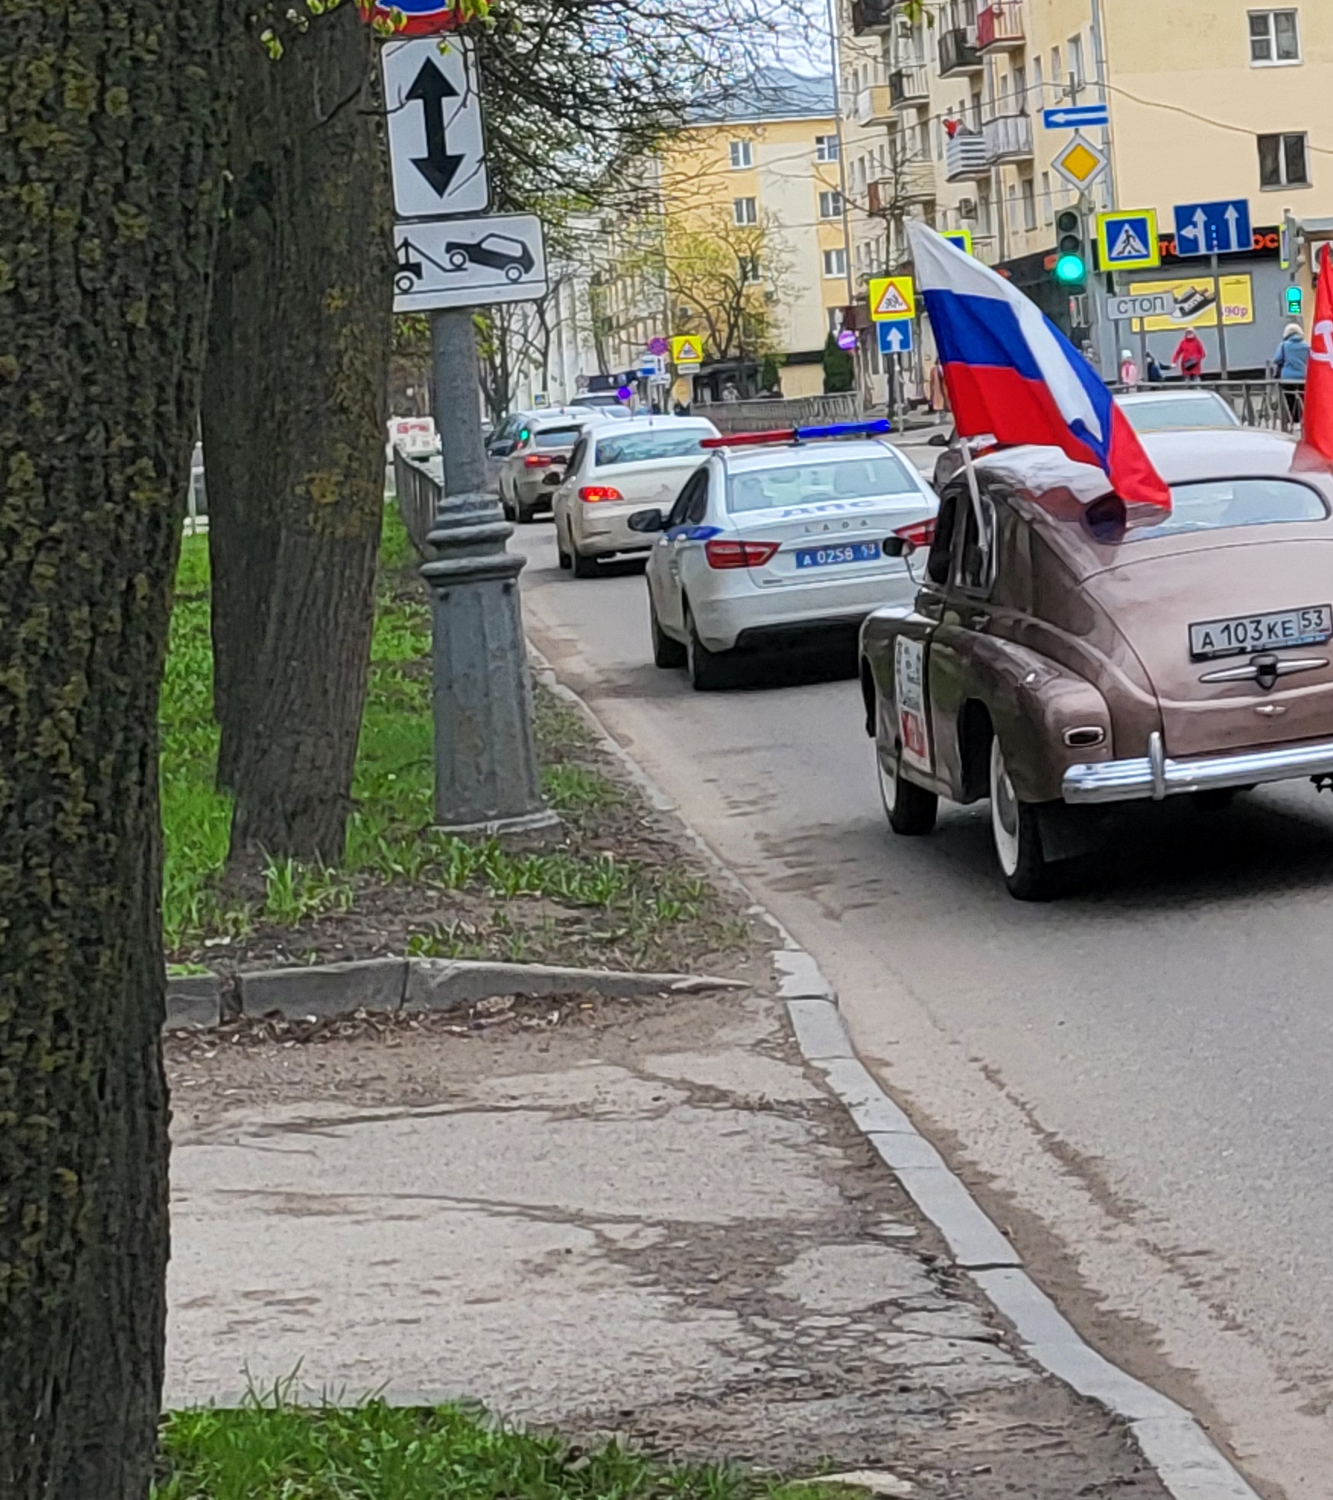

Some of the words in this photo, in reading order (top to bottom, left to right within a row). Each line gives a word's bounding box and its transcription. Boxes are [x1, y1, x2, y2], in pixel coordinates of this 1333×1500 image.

[1117, 295, 1165, 315] СТОП
[1201, 619, 1296, 650] А103КЕ
[1301, 609, 1323, 628] 53
